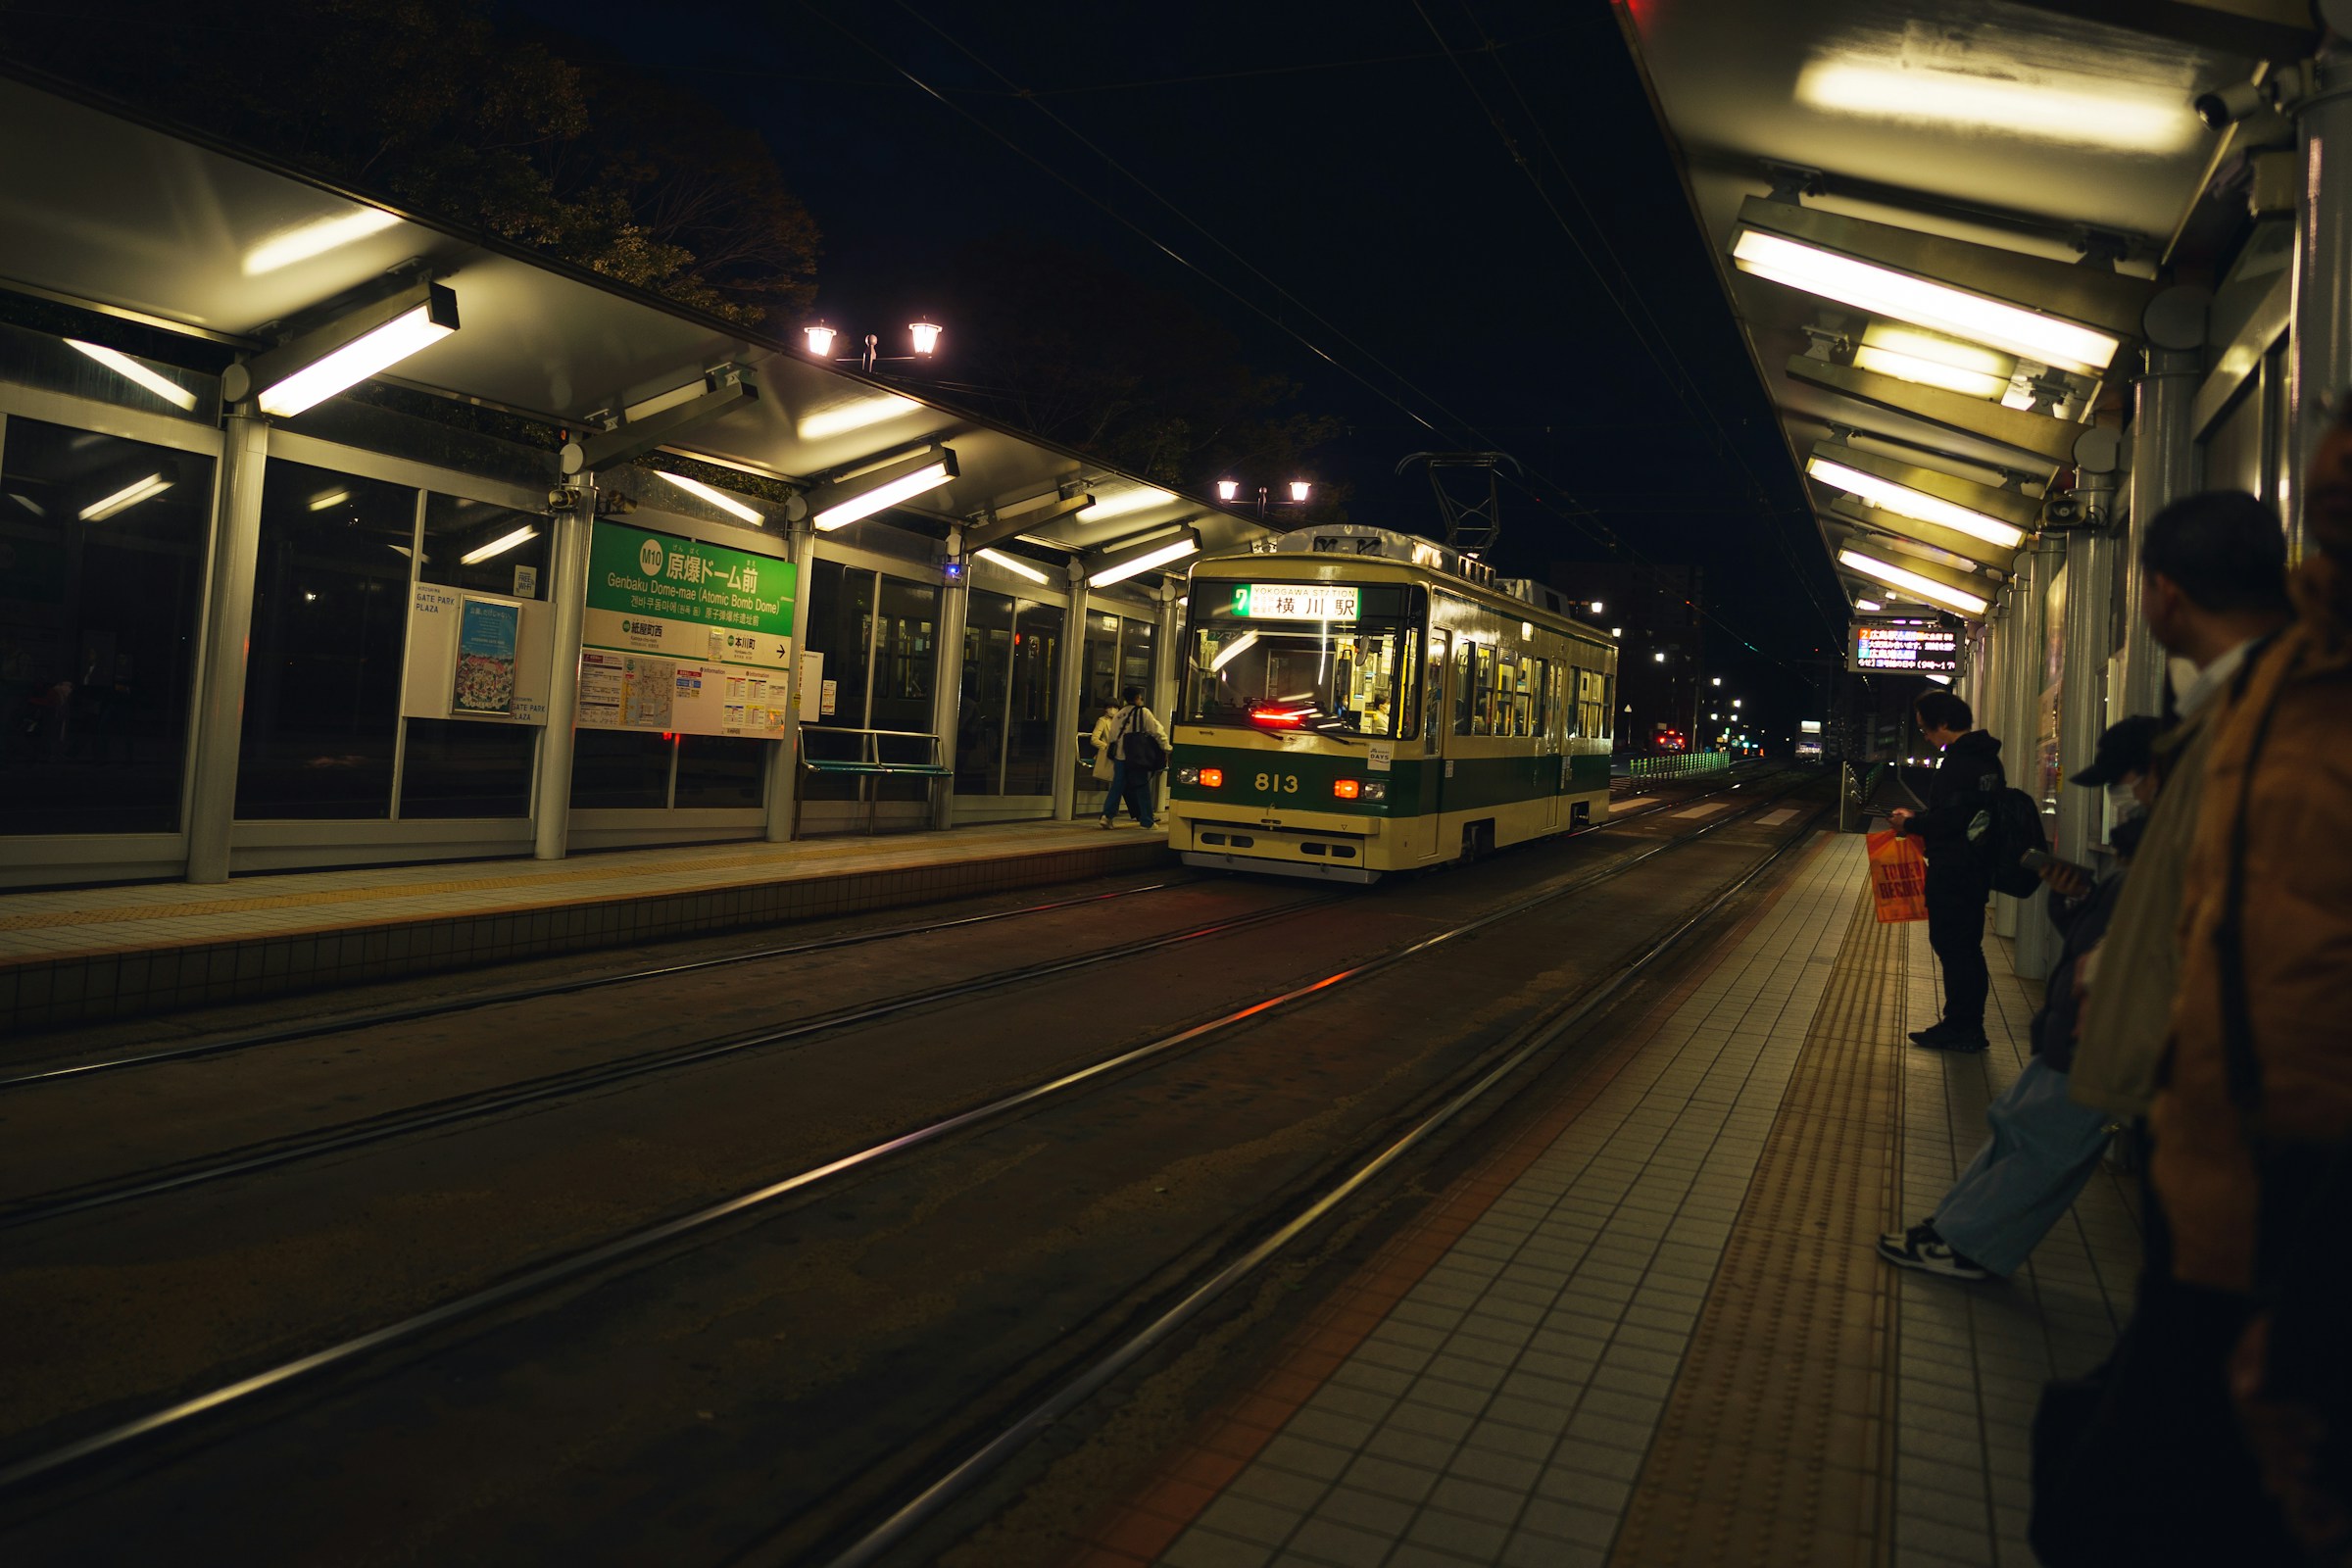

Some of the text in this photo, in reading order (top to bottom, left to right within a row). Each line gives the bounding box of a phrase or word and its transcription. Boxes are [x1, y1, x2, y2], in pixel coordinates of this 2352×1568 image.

[641, 549, 662, 566] M10
[666, 552, 759, 594] 原爆ドーム前
[416, 593, 455, 606] GATE PARK
[608, 571, 780, 614] Genbaku Dome-mae (Atomic Bomb Dome)
[1236, 589, 1248, 611] 7
[416, 604, 438, 613] PLAZA
[1276, 597, 1355, 616] 横川駅
[735, 637, 756, 650] 本川町
[1862, 630, 1869, 639] 2
[1254, 773, 1298, 793] 813
